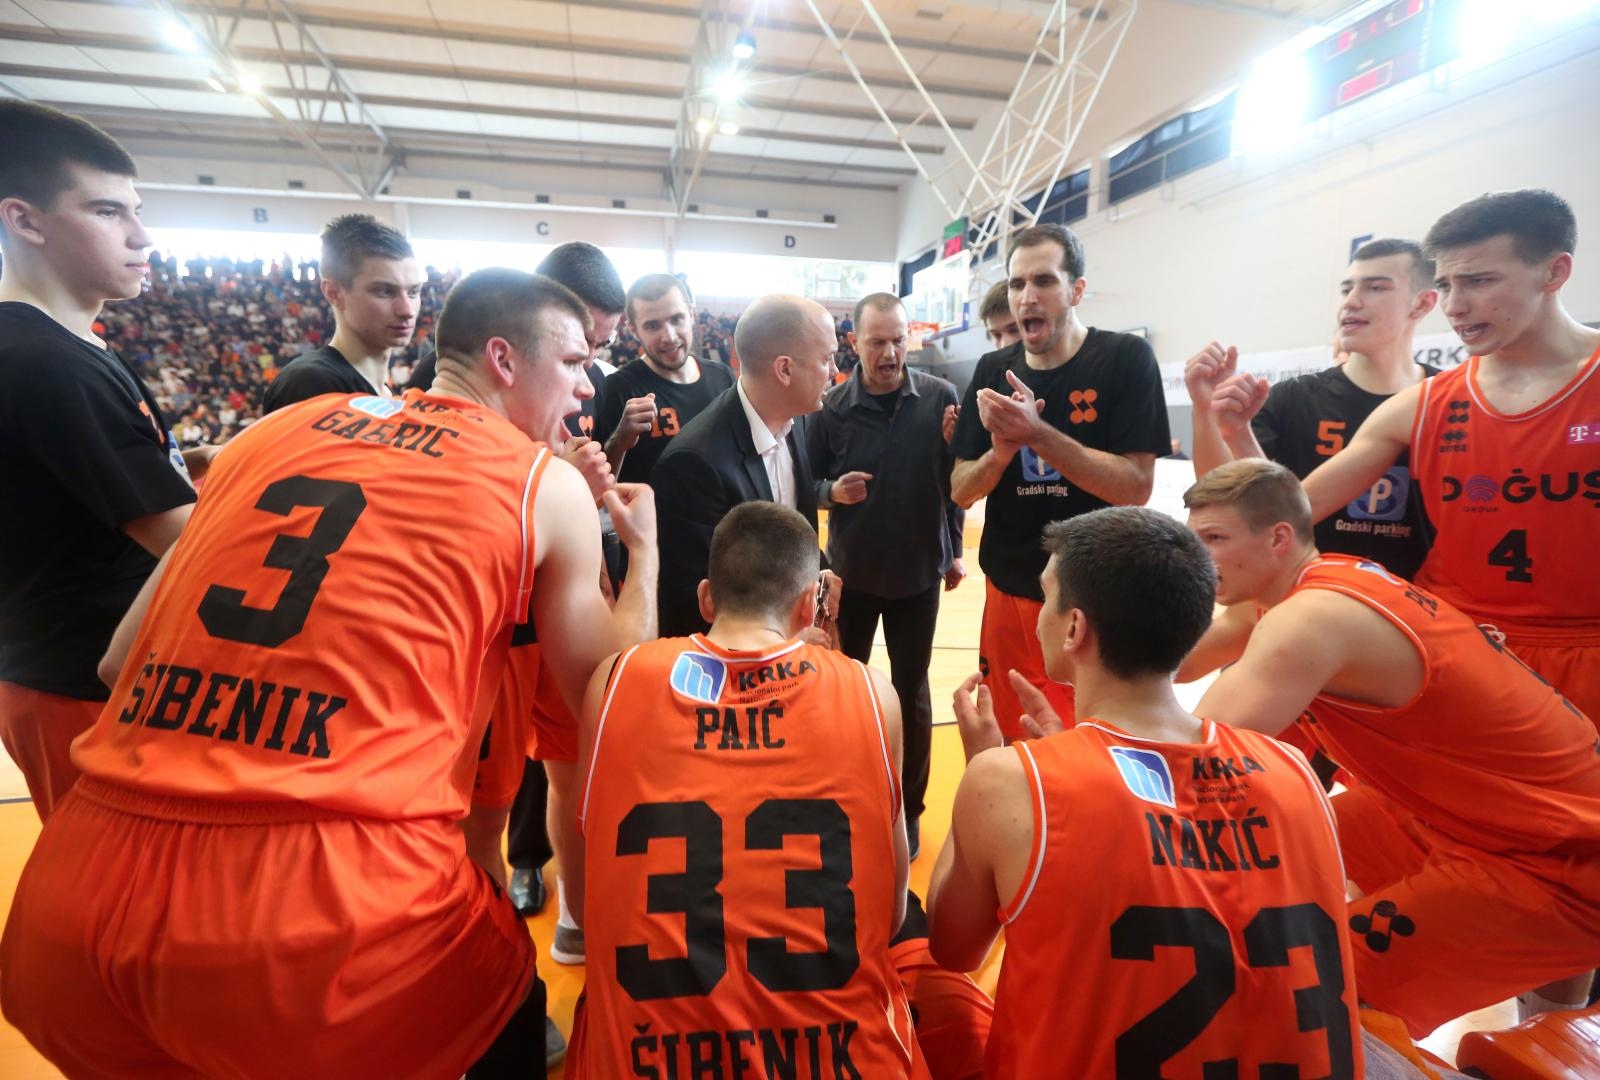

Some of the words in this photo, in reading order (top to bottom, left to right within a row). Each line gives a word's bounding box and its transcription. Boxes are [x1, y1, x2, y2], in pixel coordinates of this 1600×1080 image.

[253, 207, 269, 223] B
[536, 221, 549, 236] C
[784, 235, 796, 248] D
[650, 407, 680, 437] 13
[1315, 420, 1346, 456] 5
[1016, 484, 1045, 496] Gradski
[1335, 519, 1372, 533] Gradski
[196, 475, 368, 649] 3
[1487, 529, 1533, 583] 4
[738, 660, 816, 692] KRKA
[118, 652, 348, 760] ŠIBENIK
[693, 699, 786, 750] PAIĆ
[1192, 755, 1266, 781] KRKA
[1144, 807, 1281, 872] NAKIĆ
[615, 798, 861, 1002] 33
[1110, 902, 1355, 1080] 23
[630, 1020, 863, 1080] ŠIBENIK
